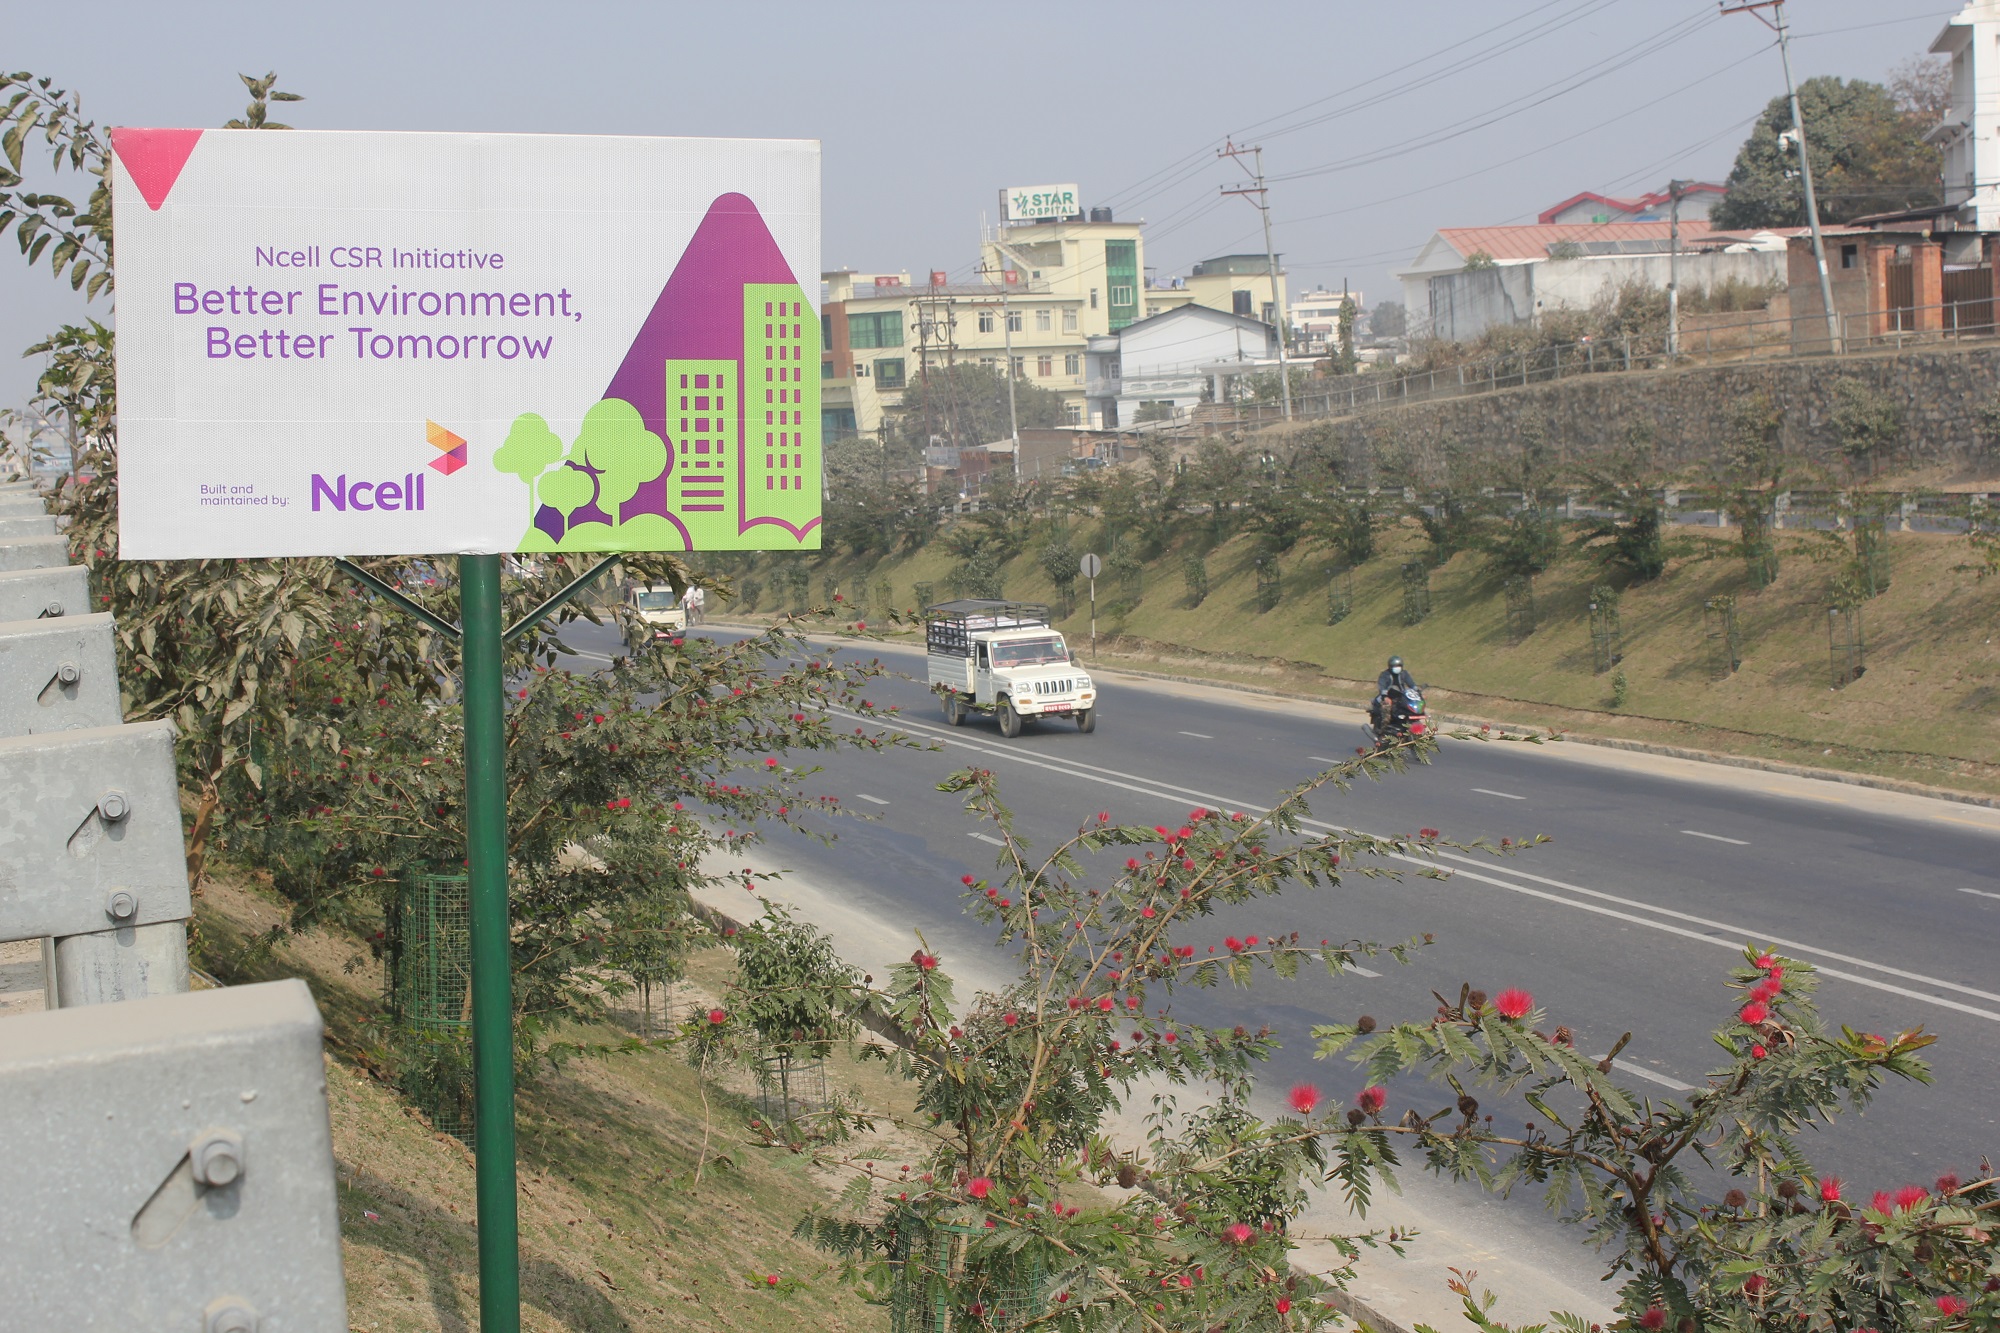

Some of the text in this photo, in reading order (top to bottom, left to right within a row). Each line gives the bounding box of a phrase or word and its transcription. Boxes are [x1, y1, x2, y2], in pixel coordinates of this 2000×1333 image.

[1032, 191, 1074, 207] STAR
[1021, 206, 1075, 217] HOSPITAL
[255, 245, 505, 270] Ncell CSR Initiative
[174, 282, 583, 322] Better Environment,
[206, 326, 553, 360] Better Tomorrow
[200, 484, 253, 494] Built and
[311, 473, 425, 512] Ncell
[200, 495, 290, 507] maintained by:
